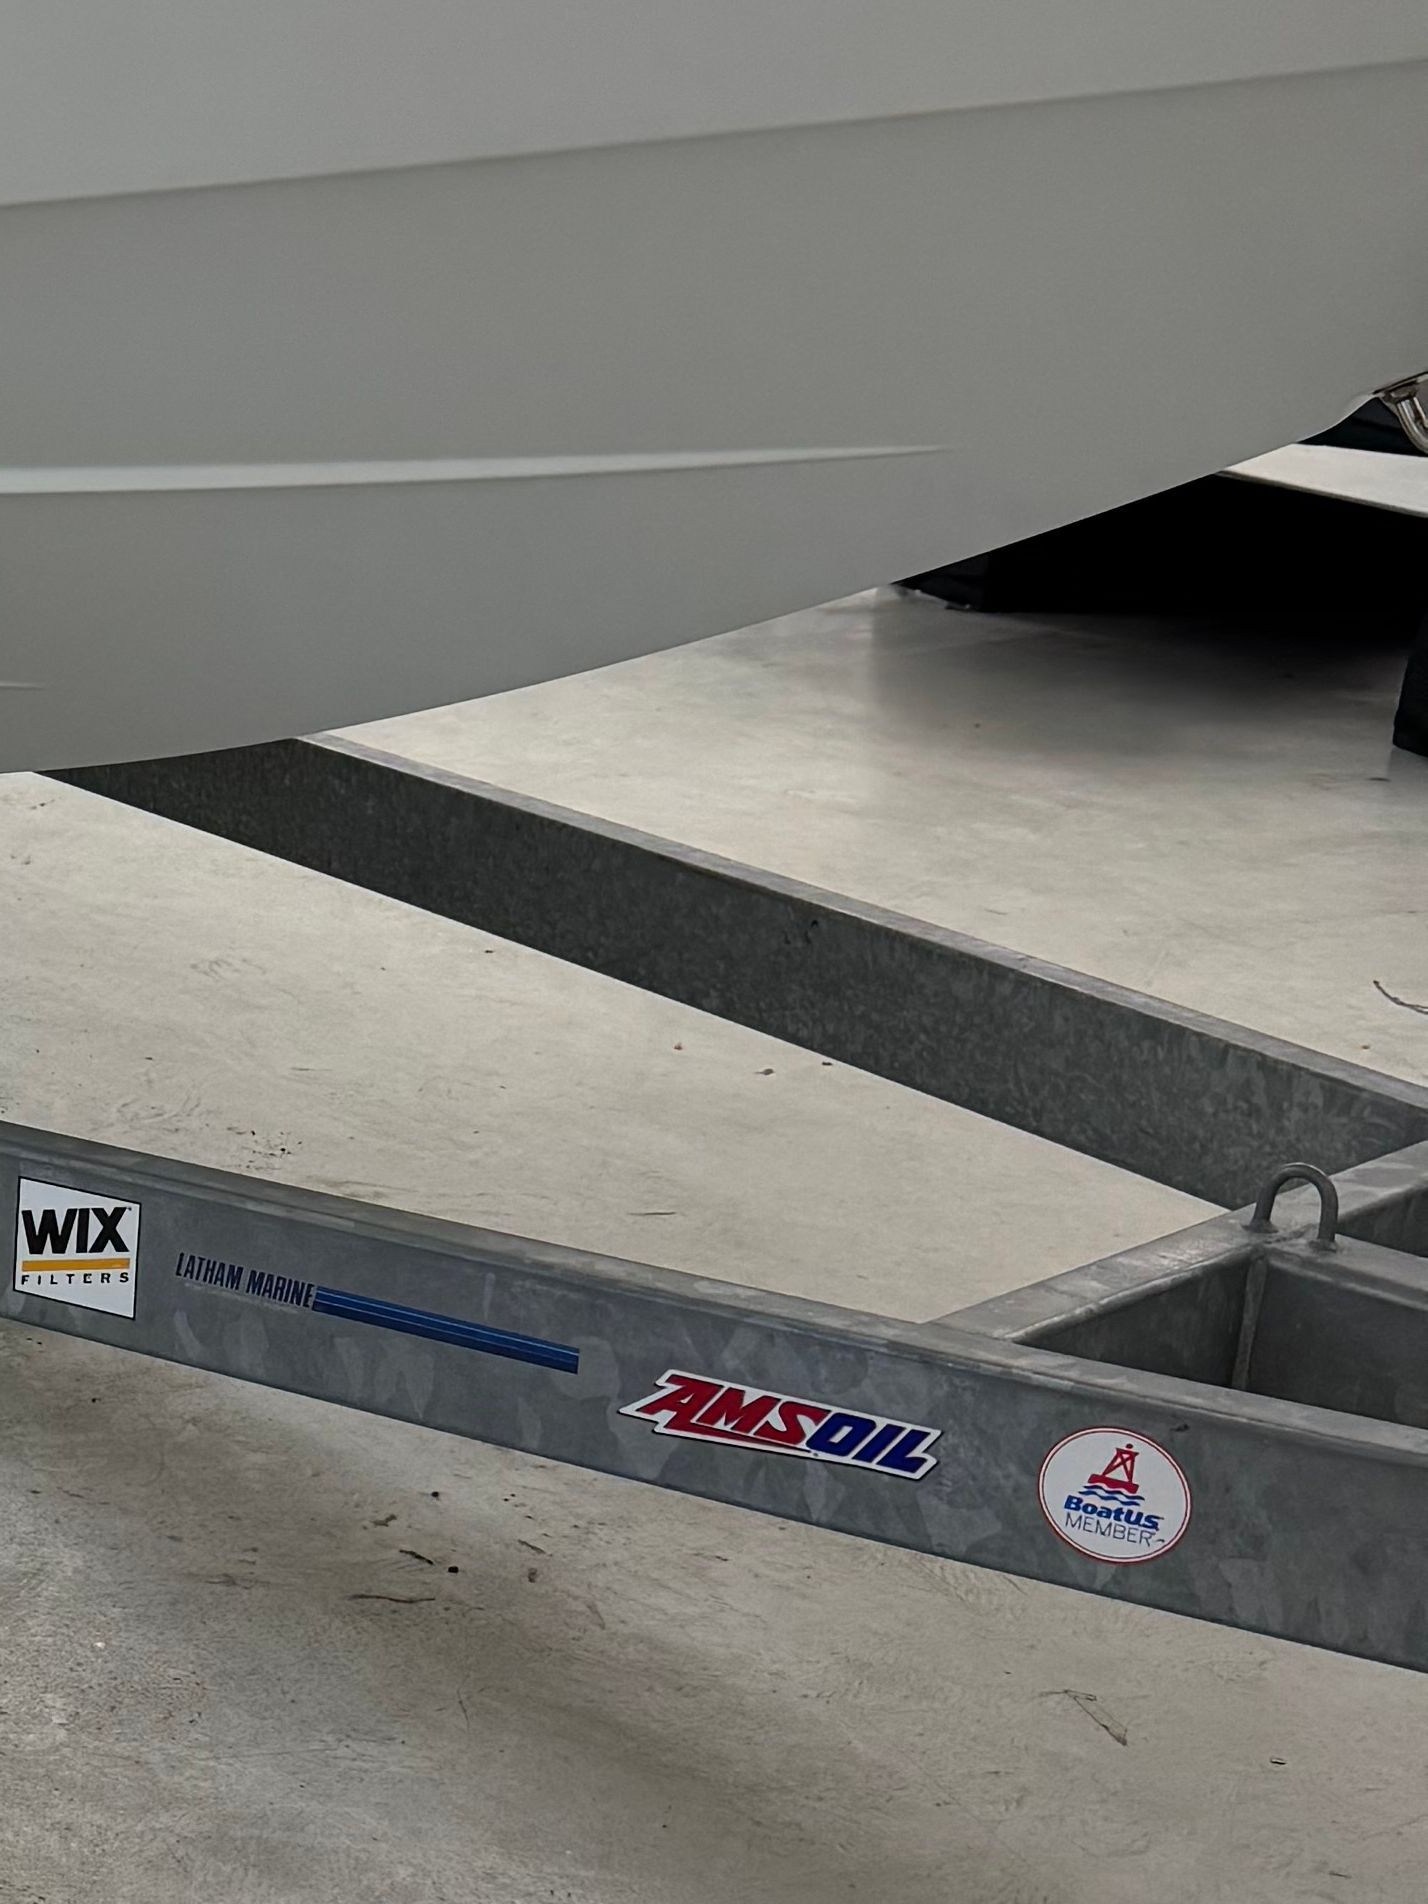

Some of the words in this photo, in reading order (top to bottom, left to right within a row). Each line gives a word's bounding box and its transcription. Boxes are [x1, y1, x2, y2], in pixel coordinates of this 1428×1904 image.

[21, 1206, 130, 1255] WIX
[21, 1272, 130, 1286] FILTERS
[175, 1252, 244, 1291] LATHAM
[245, 1269, 316, 1308] MARINE
[635, 1373, 932, 1474] AMSOIL
[1065, 1512, 1155, 1547] MEMBER
